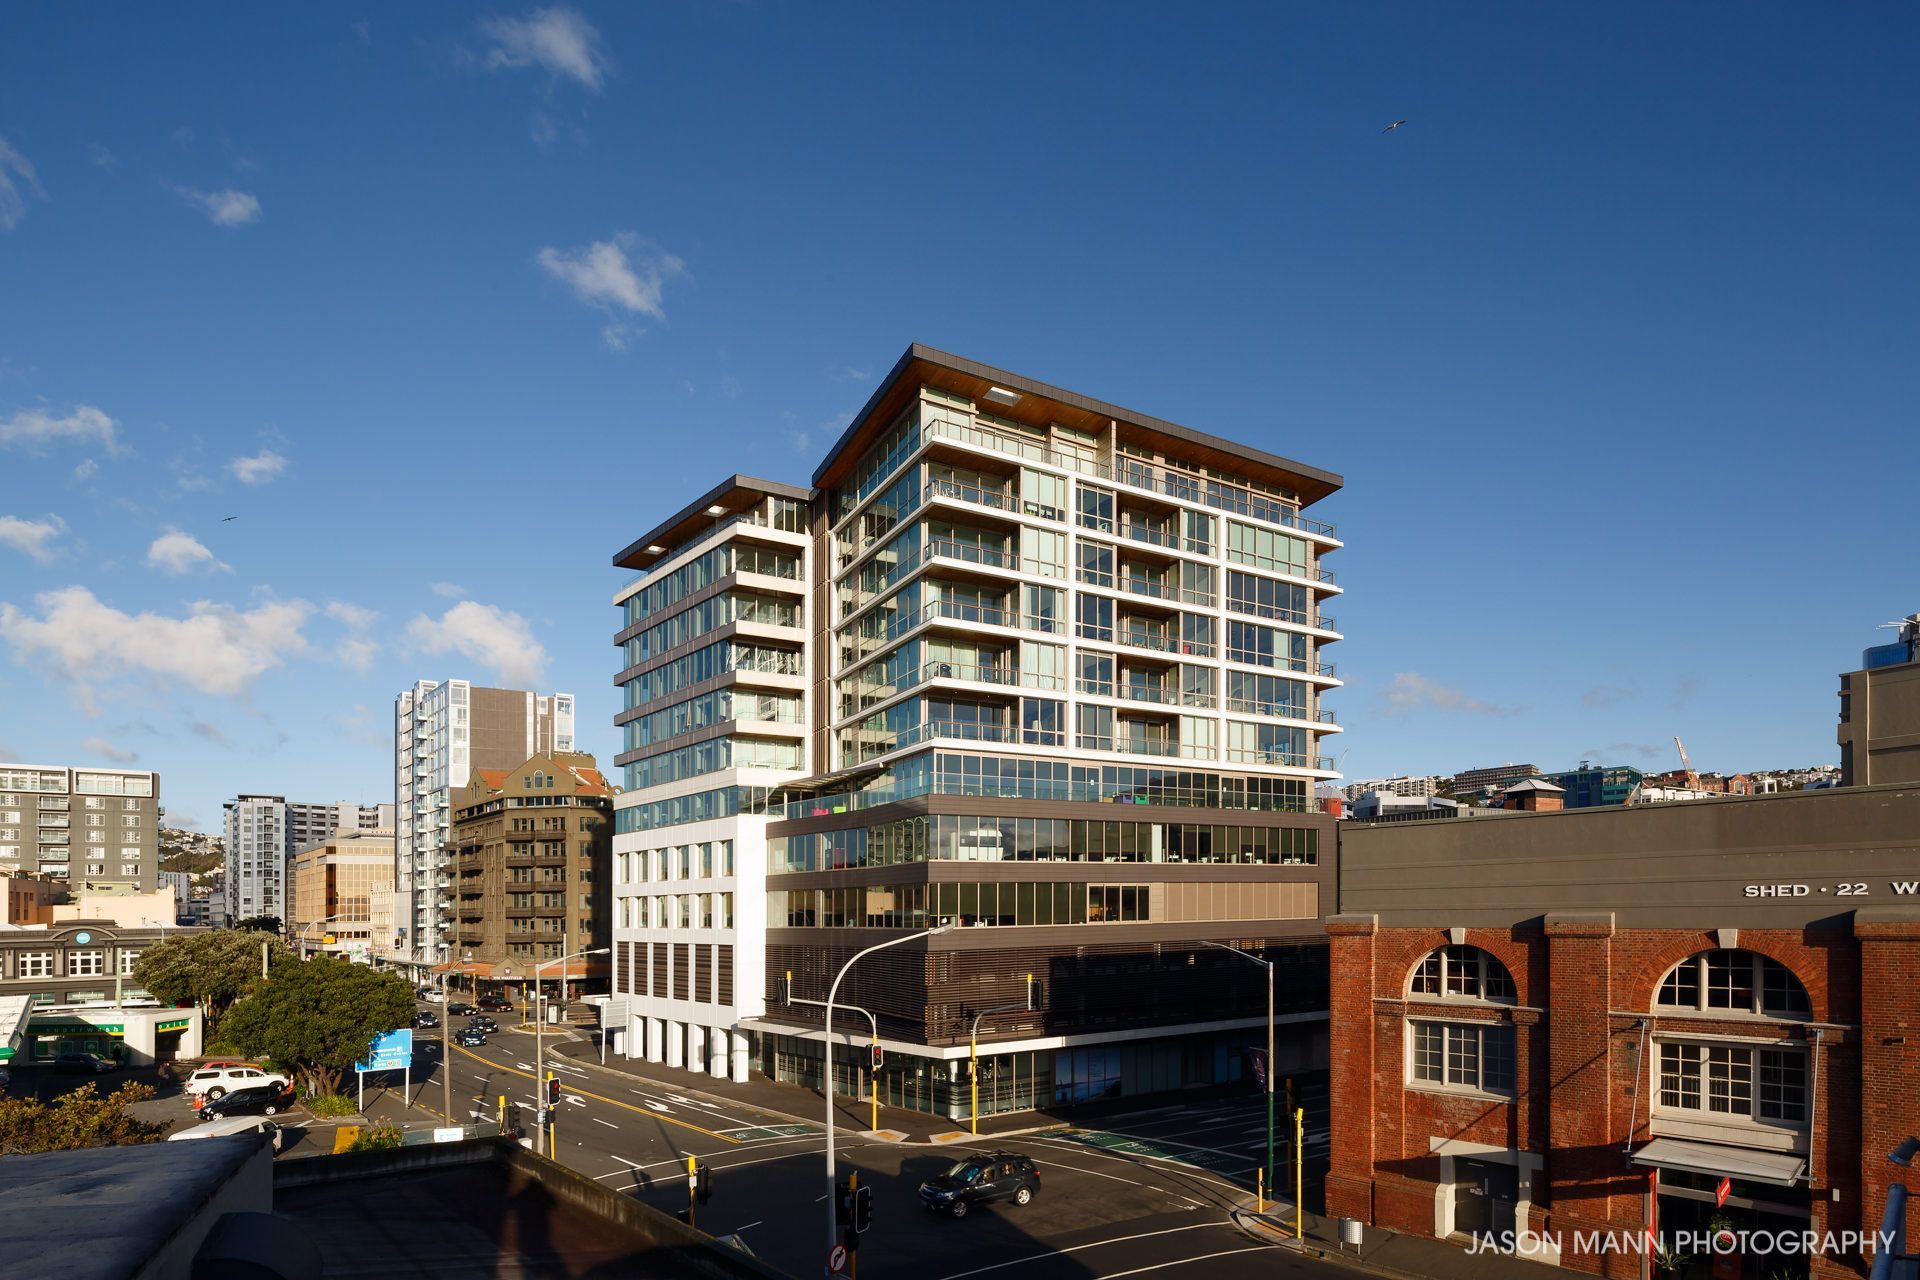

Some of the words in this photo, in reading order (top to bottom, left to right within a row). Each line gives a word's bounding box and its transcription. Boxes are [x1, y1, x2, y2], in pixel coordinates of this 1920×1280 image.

[1744, 884, 1810, 898] SHED
[1836, 882, 1869, 896] 22
[158, 1021, 183, 1029] exit
